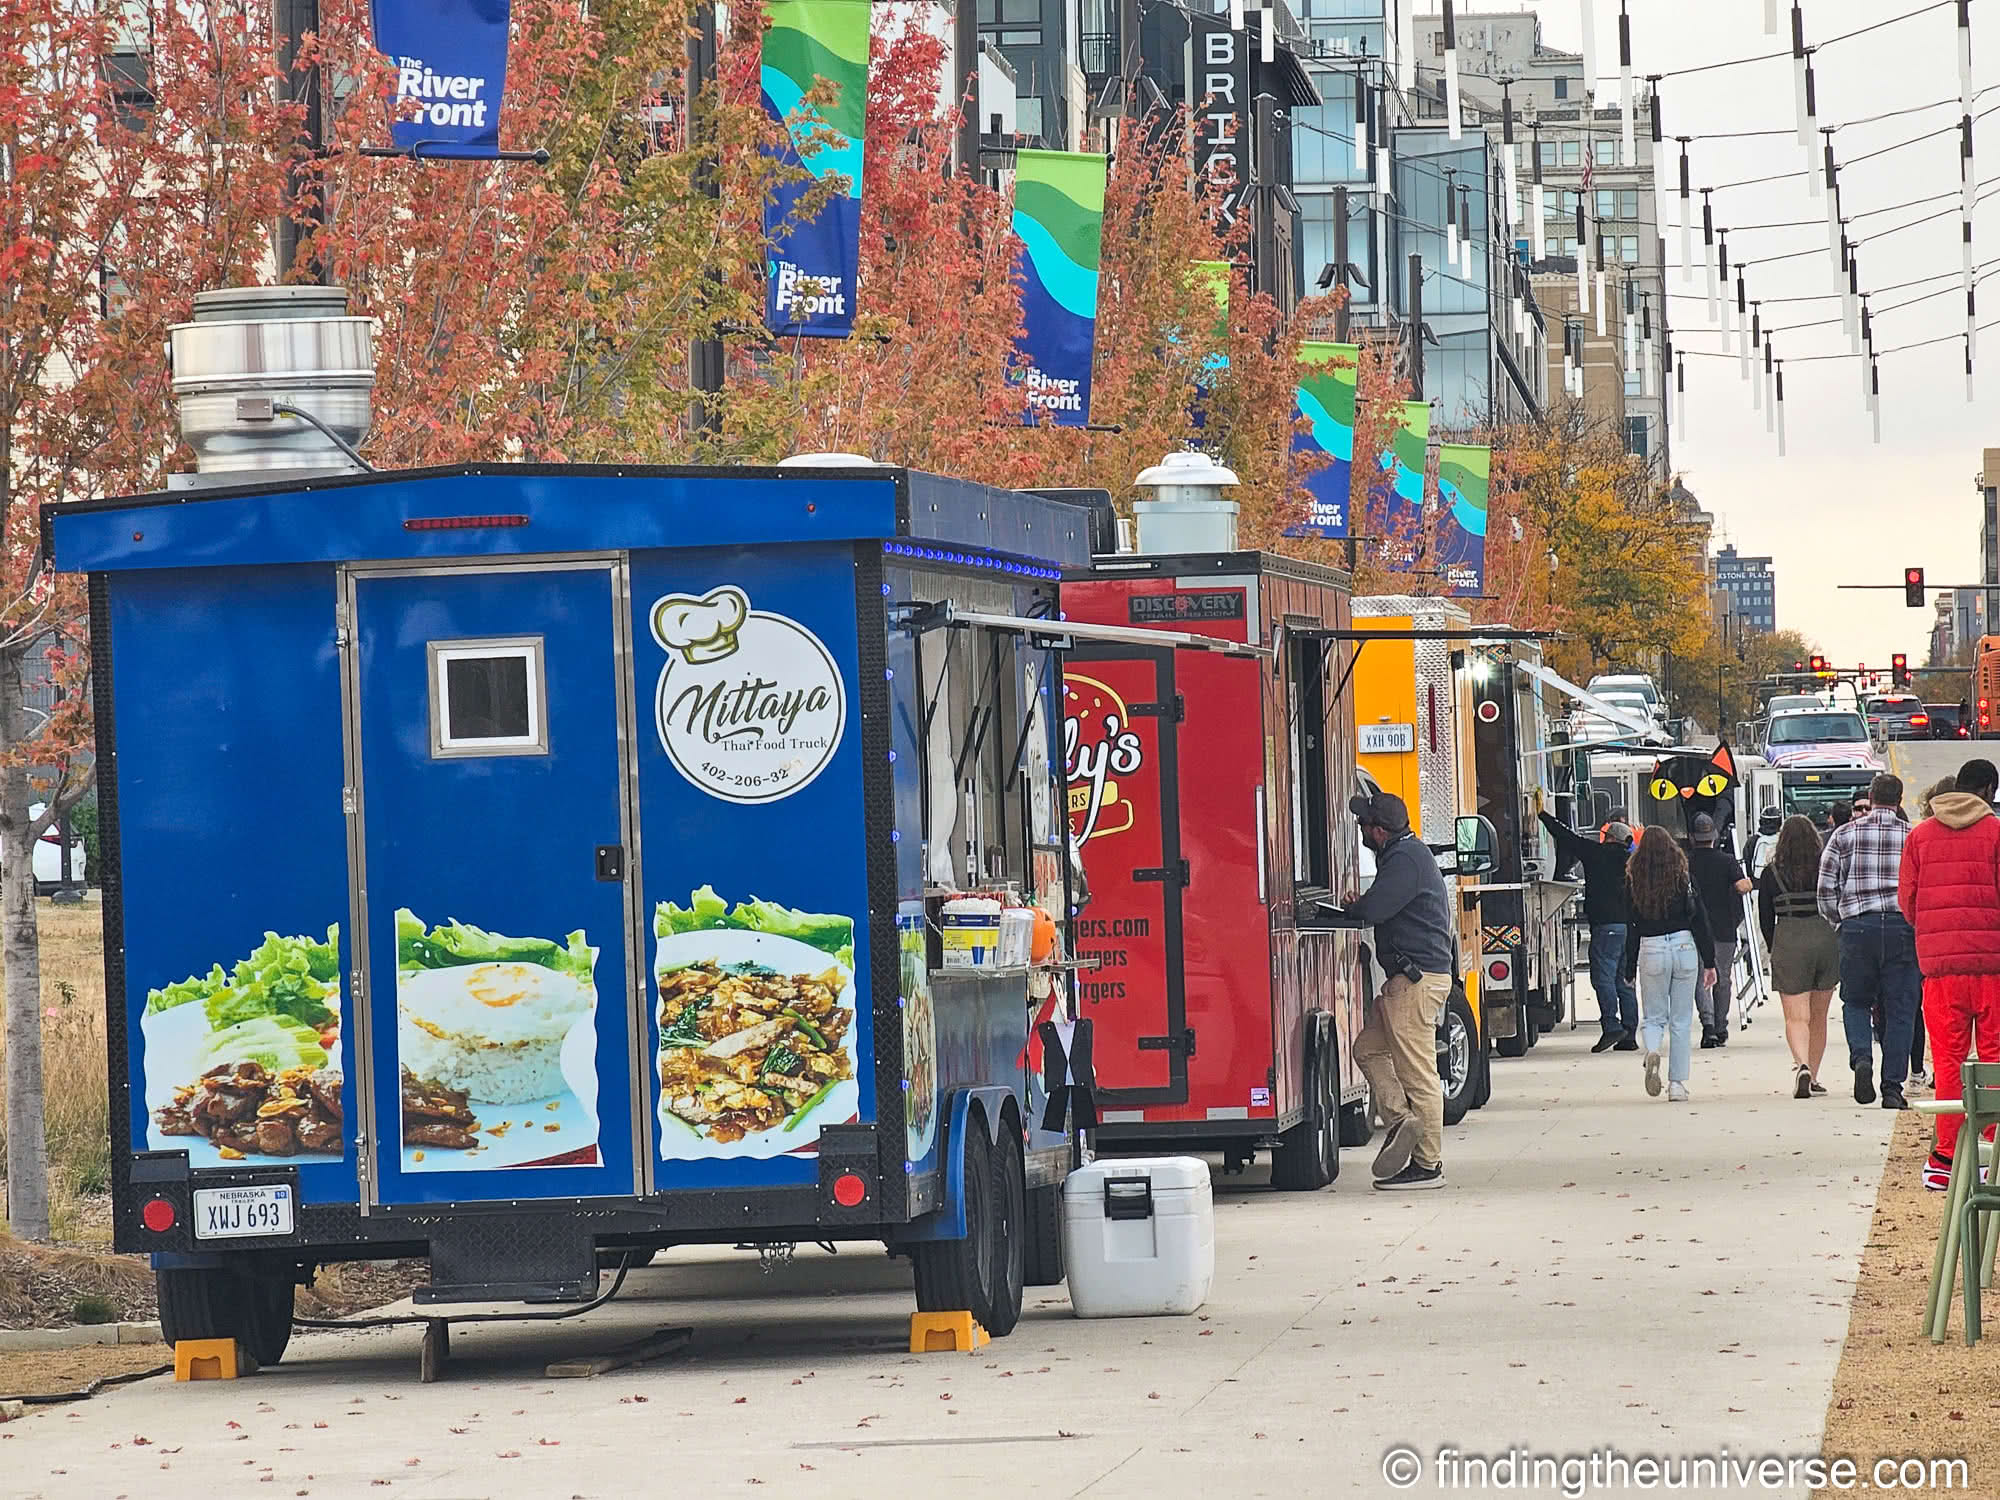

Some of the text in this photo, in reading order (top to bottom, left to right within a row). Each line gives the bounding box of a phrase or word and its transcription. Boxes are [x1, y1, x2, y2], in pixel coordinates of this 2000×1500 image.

[399, 56, 423, 68] The
[398, 67, 485, 99] River
[779, 261, 797, 271] The
[1306, 500, 1341, 514] iver
[1304, 514, 1343, 526] ront
[1749, 571, 1772, 579] PLAZA
[666, 678, 832, 744] Nittaya
[721, 737, 828, 751] Thai Food Truck
[1367, 734, 1384, 748] XXH
[701, 759, 801, 787] 402-206-32
[220, 1191, 266, 1200] NEBRASKA
[208, 1203, 279, 1230] XWJ 693
